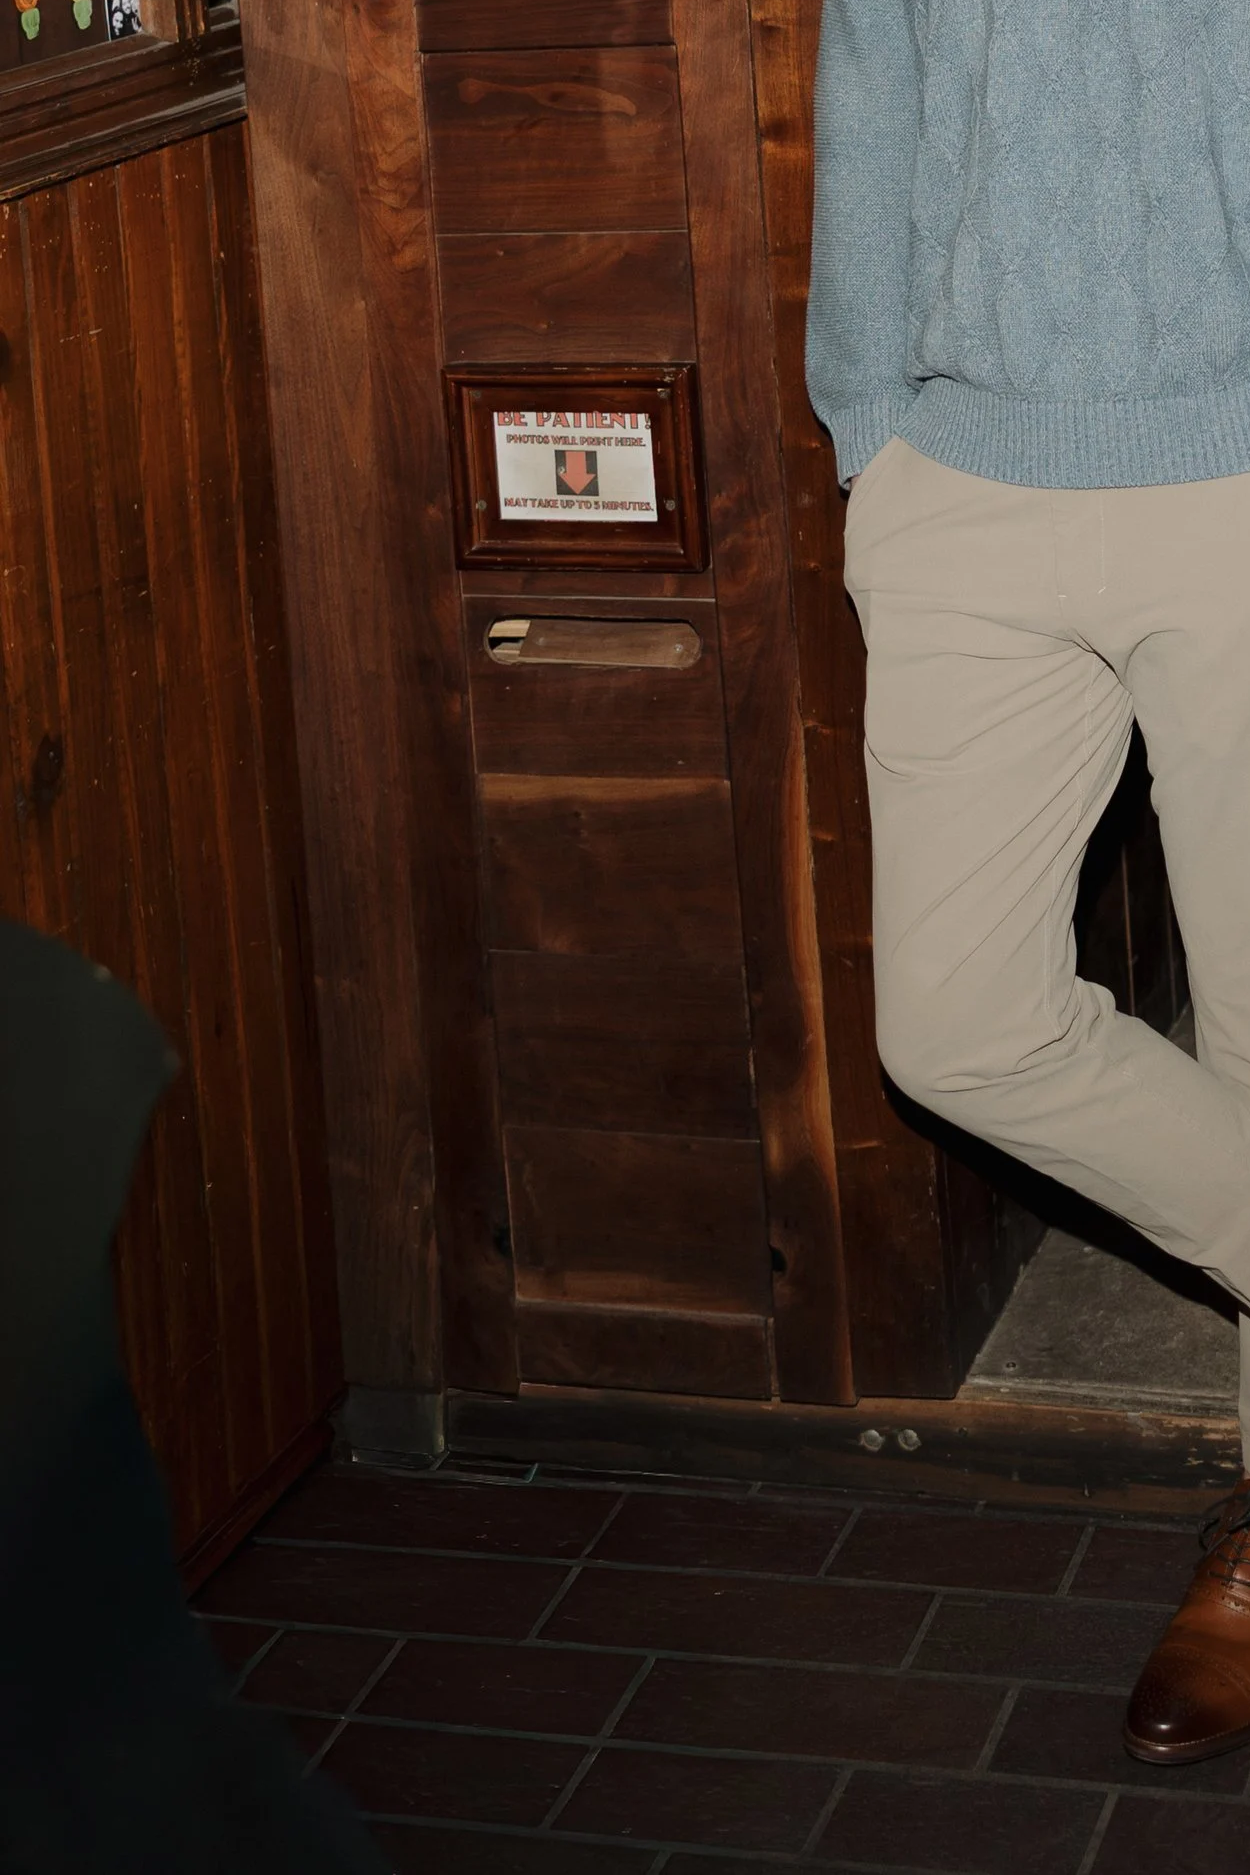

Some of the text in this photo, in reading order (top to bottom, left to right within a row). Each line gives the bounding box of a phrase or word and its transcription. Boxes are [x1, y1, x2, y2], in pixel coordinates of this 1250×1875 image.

[497, 411, 652, 430] BE PATIENT!
[506, 433, 646, 448] PHOTOS WILL PRINT HERE.
[504, 497, 529, 508] MAY
[529, 498, 559, 510] TAKE
[561, 500, 576, 510] UP
[576, 500, 592, 511] TO
[601, 500, 654, 512] MINUTES.
